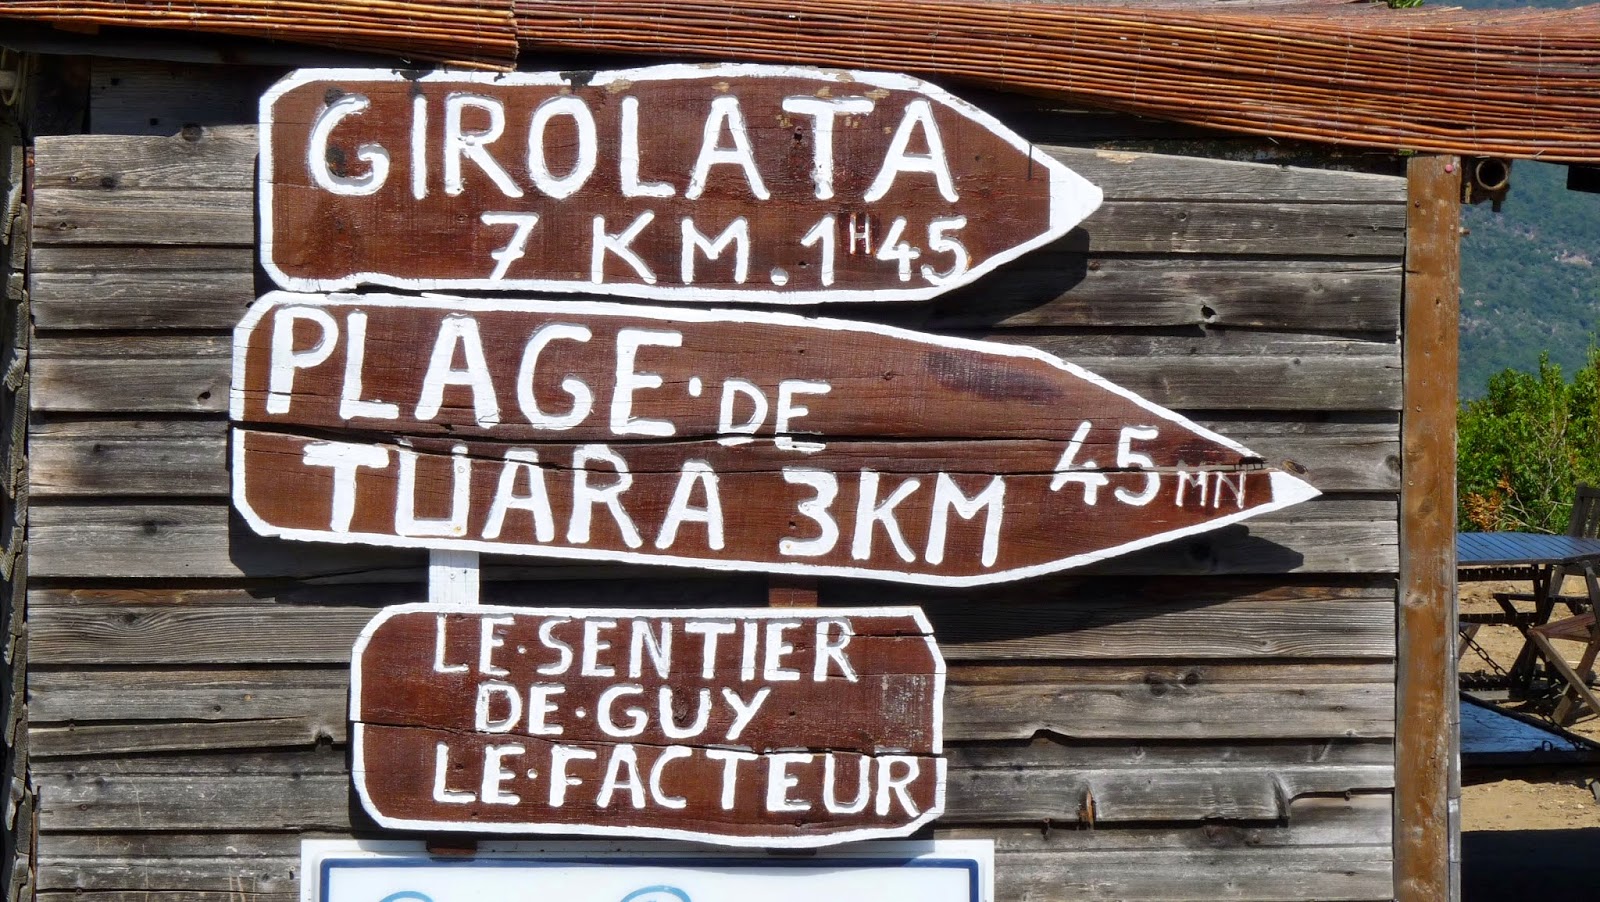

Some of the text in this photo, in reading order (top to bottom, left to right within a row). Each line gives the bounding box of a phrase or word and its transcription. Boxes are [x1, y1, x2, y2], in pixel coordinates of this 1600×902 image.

[306, 92, 960, 201] GIROLATA
[480, 211, 540, 281] 7
[717, 379, 832, 454] DE
[302, 438, 726, 550] TUARA
